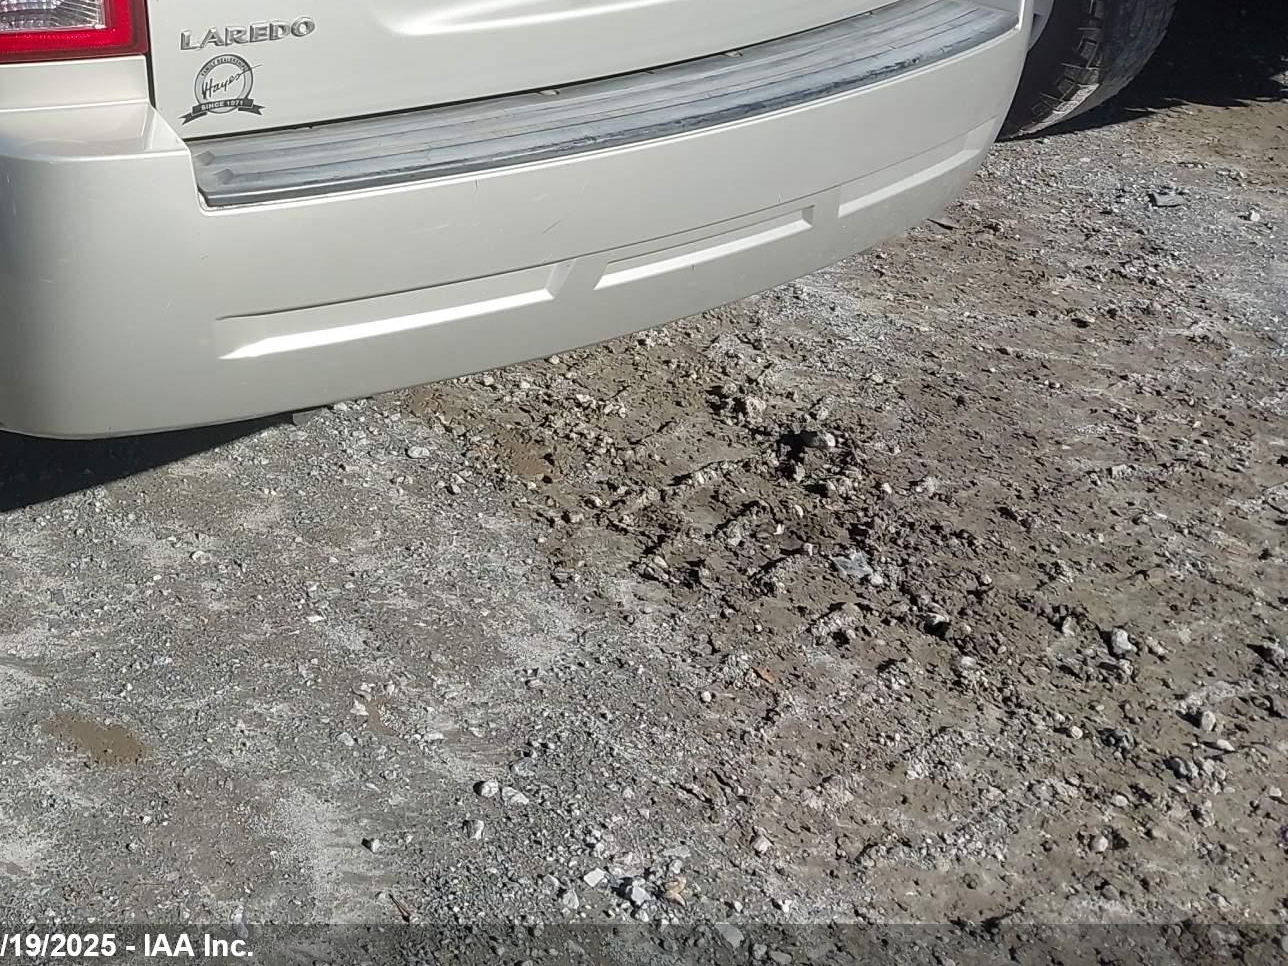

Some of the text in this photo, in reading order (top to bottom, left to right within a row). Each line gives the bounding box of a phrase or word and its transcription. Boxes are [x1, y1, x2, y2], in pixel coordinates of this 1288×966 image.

[179, 16, 316, 51] LAREDO
[201, 67, 255, 100] Hayes
[200, 100, 225, 110] SINCE
